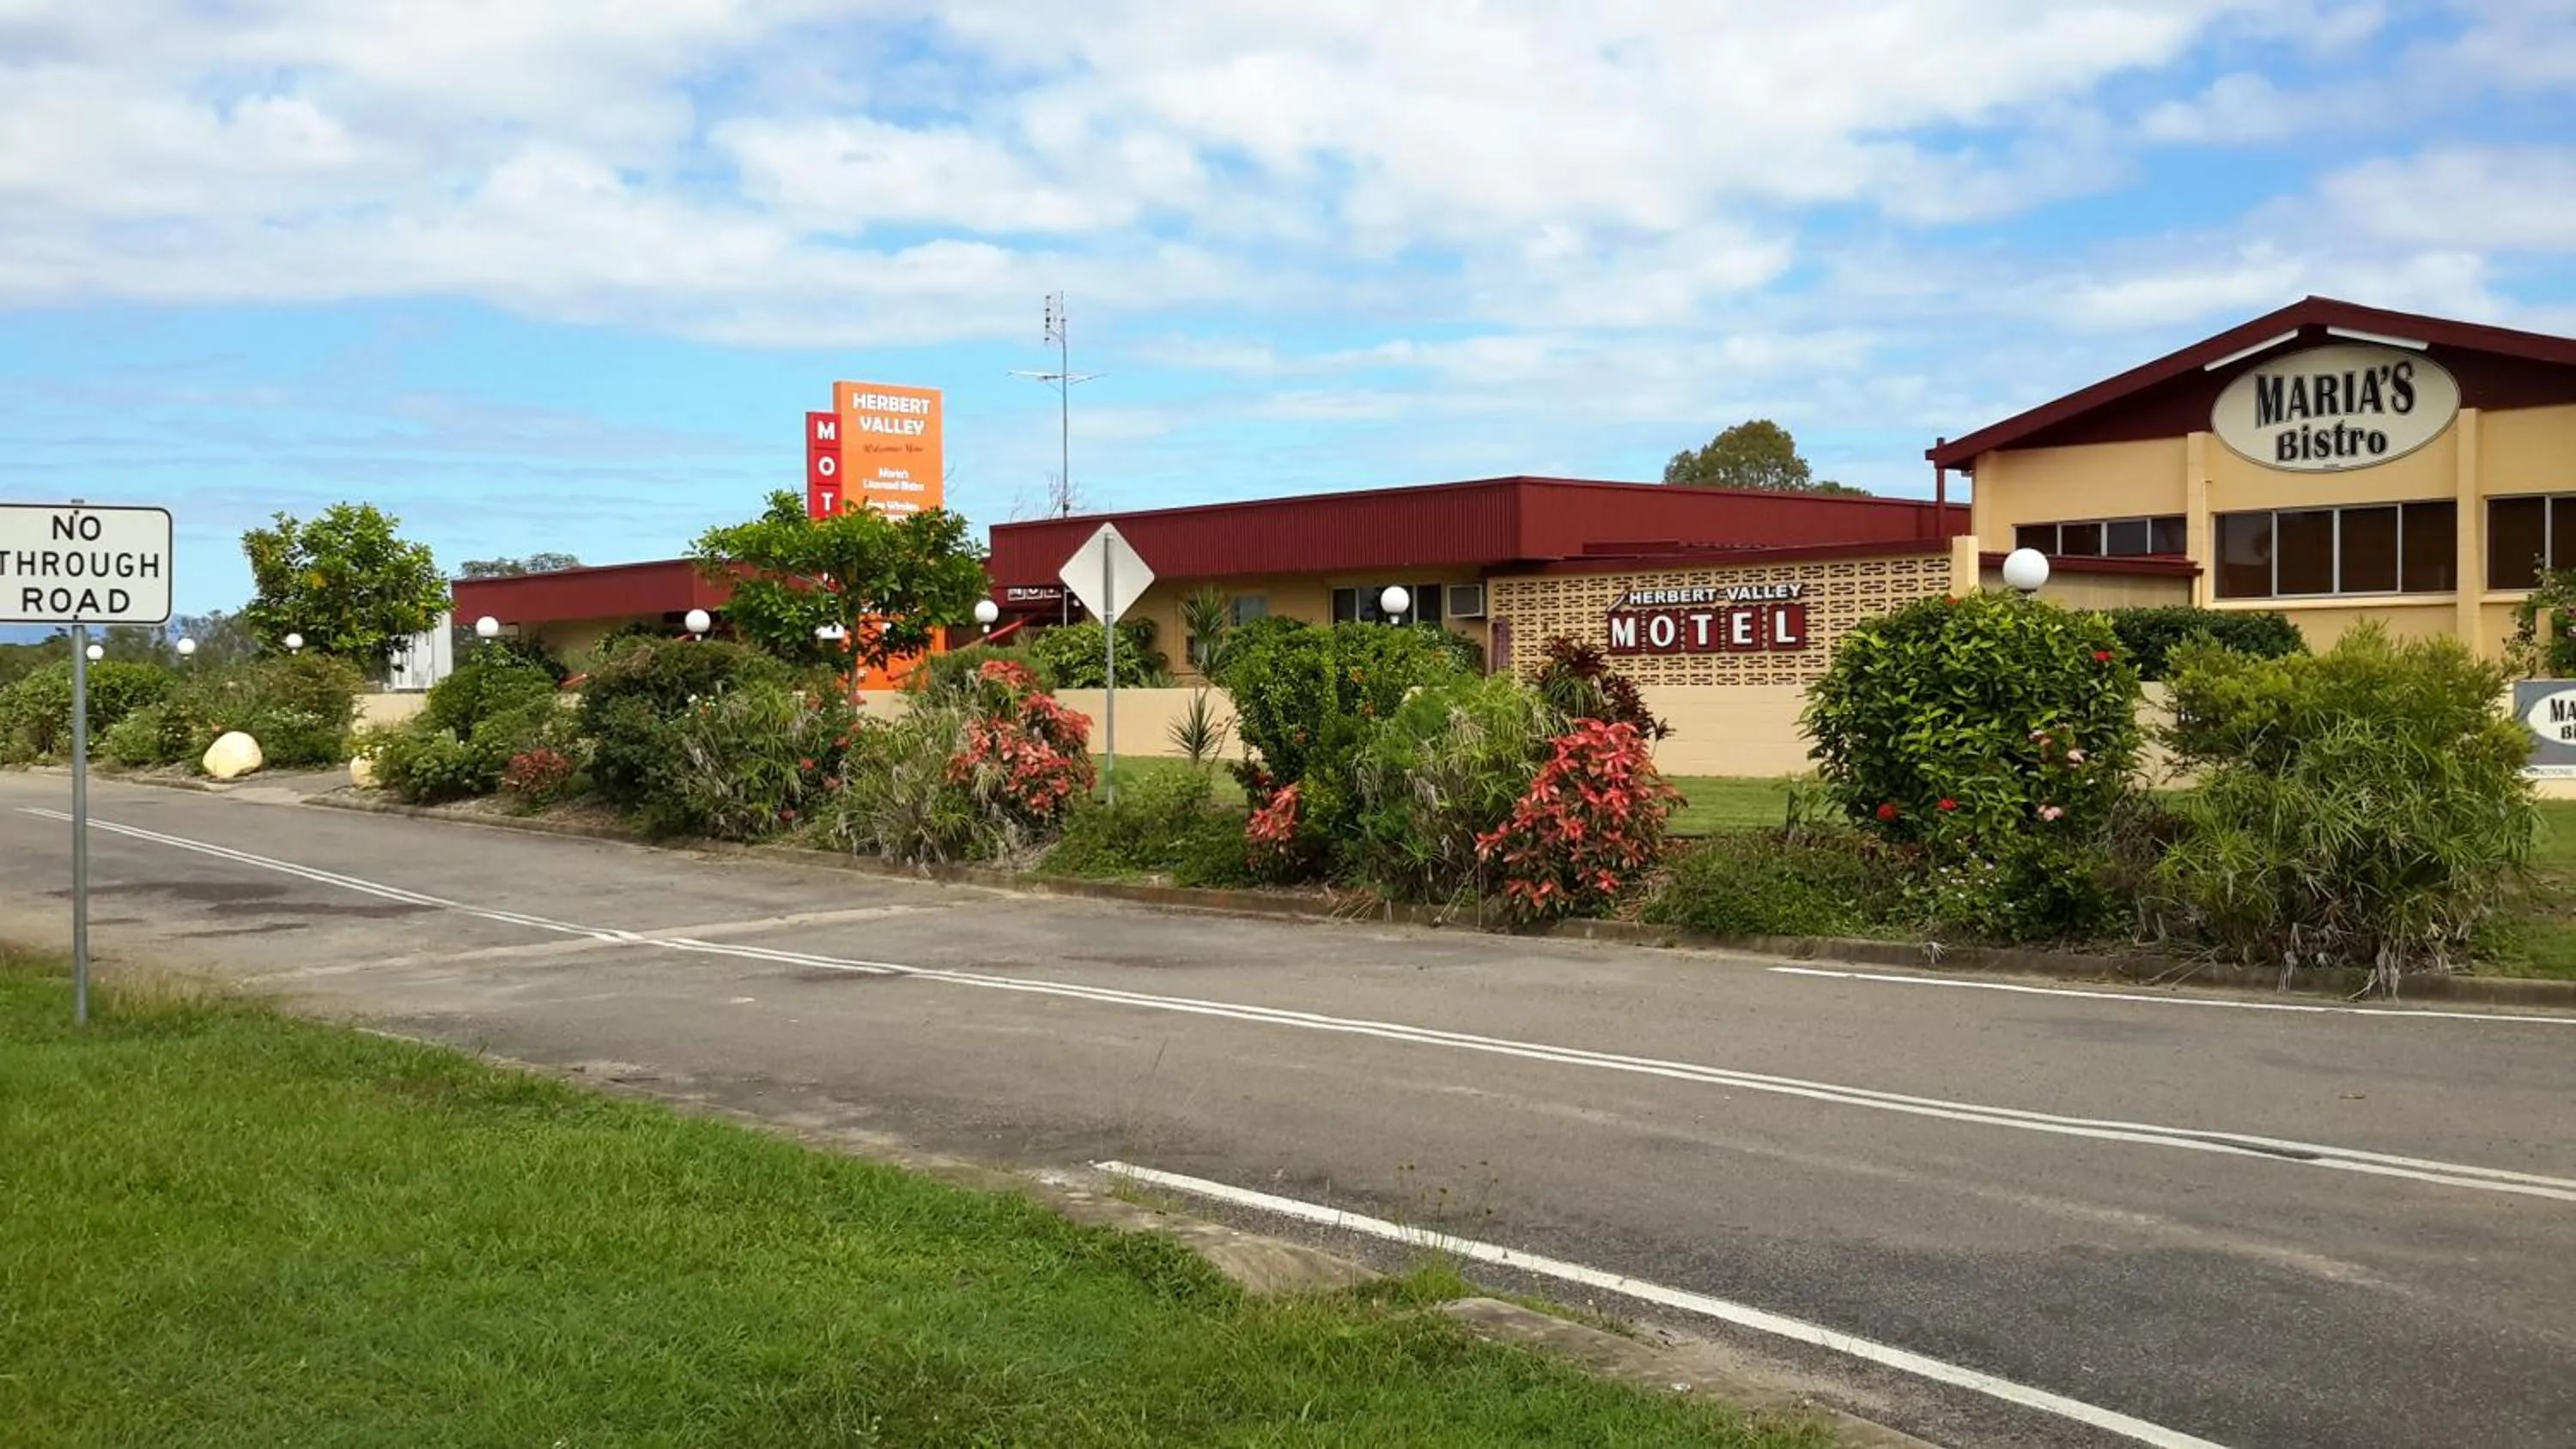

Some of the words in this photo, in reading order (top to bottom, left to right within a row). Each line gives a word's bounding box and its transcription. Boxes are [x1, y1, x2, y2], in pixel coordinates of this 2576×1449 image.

[853, 393, 930, 415] HERBERT
[2254, 361, 2416, 428] MARIA'S
[860, 415, 925, 436] VALLEY
[2276, 421, 2388, 461] Bistro
[52, 515, 101, 541] NO
[0, 550, 159, 578] THROUGH
[22, 587, 130, 614] ROAD
[1629, 588, 1716, 605] HERBERT
[1726, 584, 1802, 601] VALLEY
[1612, 610, 1796, 648] MOTEL
